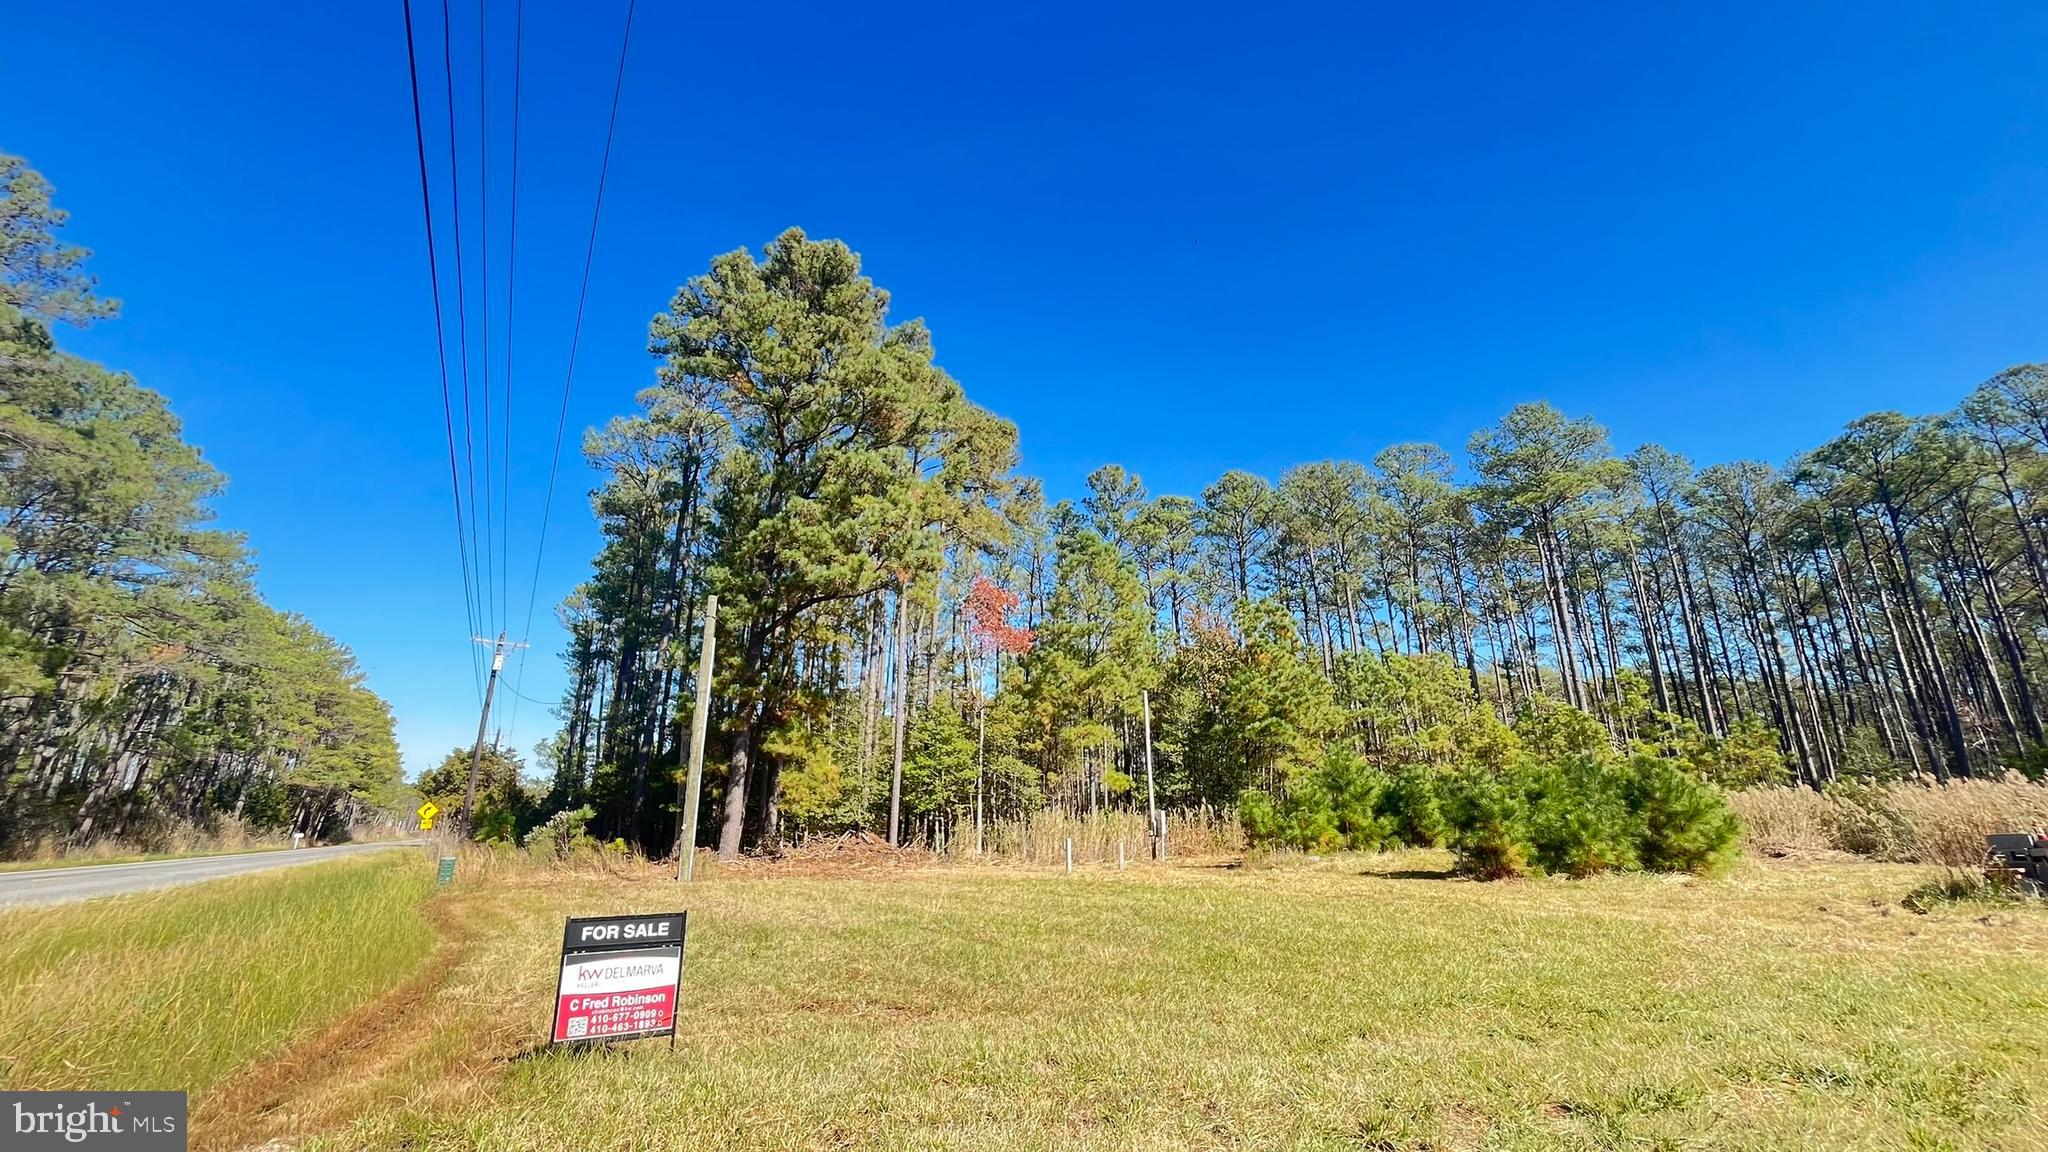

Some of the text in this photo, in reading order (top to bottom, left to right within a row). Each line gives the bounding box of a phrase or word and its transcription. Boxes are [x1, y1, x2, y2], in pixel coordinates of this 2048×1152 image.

[581, 922, 670, 941] FOR SALE
[578, 963, 664, 981] kw DELMARVA
[569, 993, 666, 1012] C Fred Robinson
[590, 1009, 657, 1024] 410-677-0909
